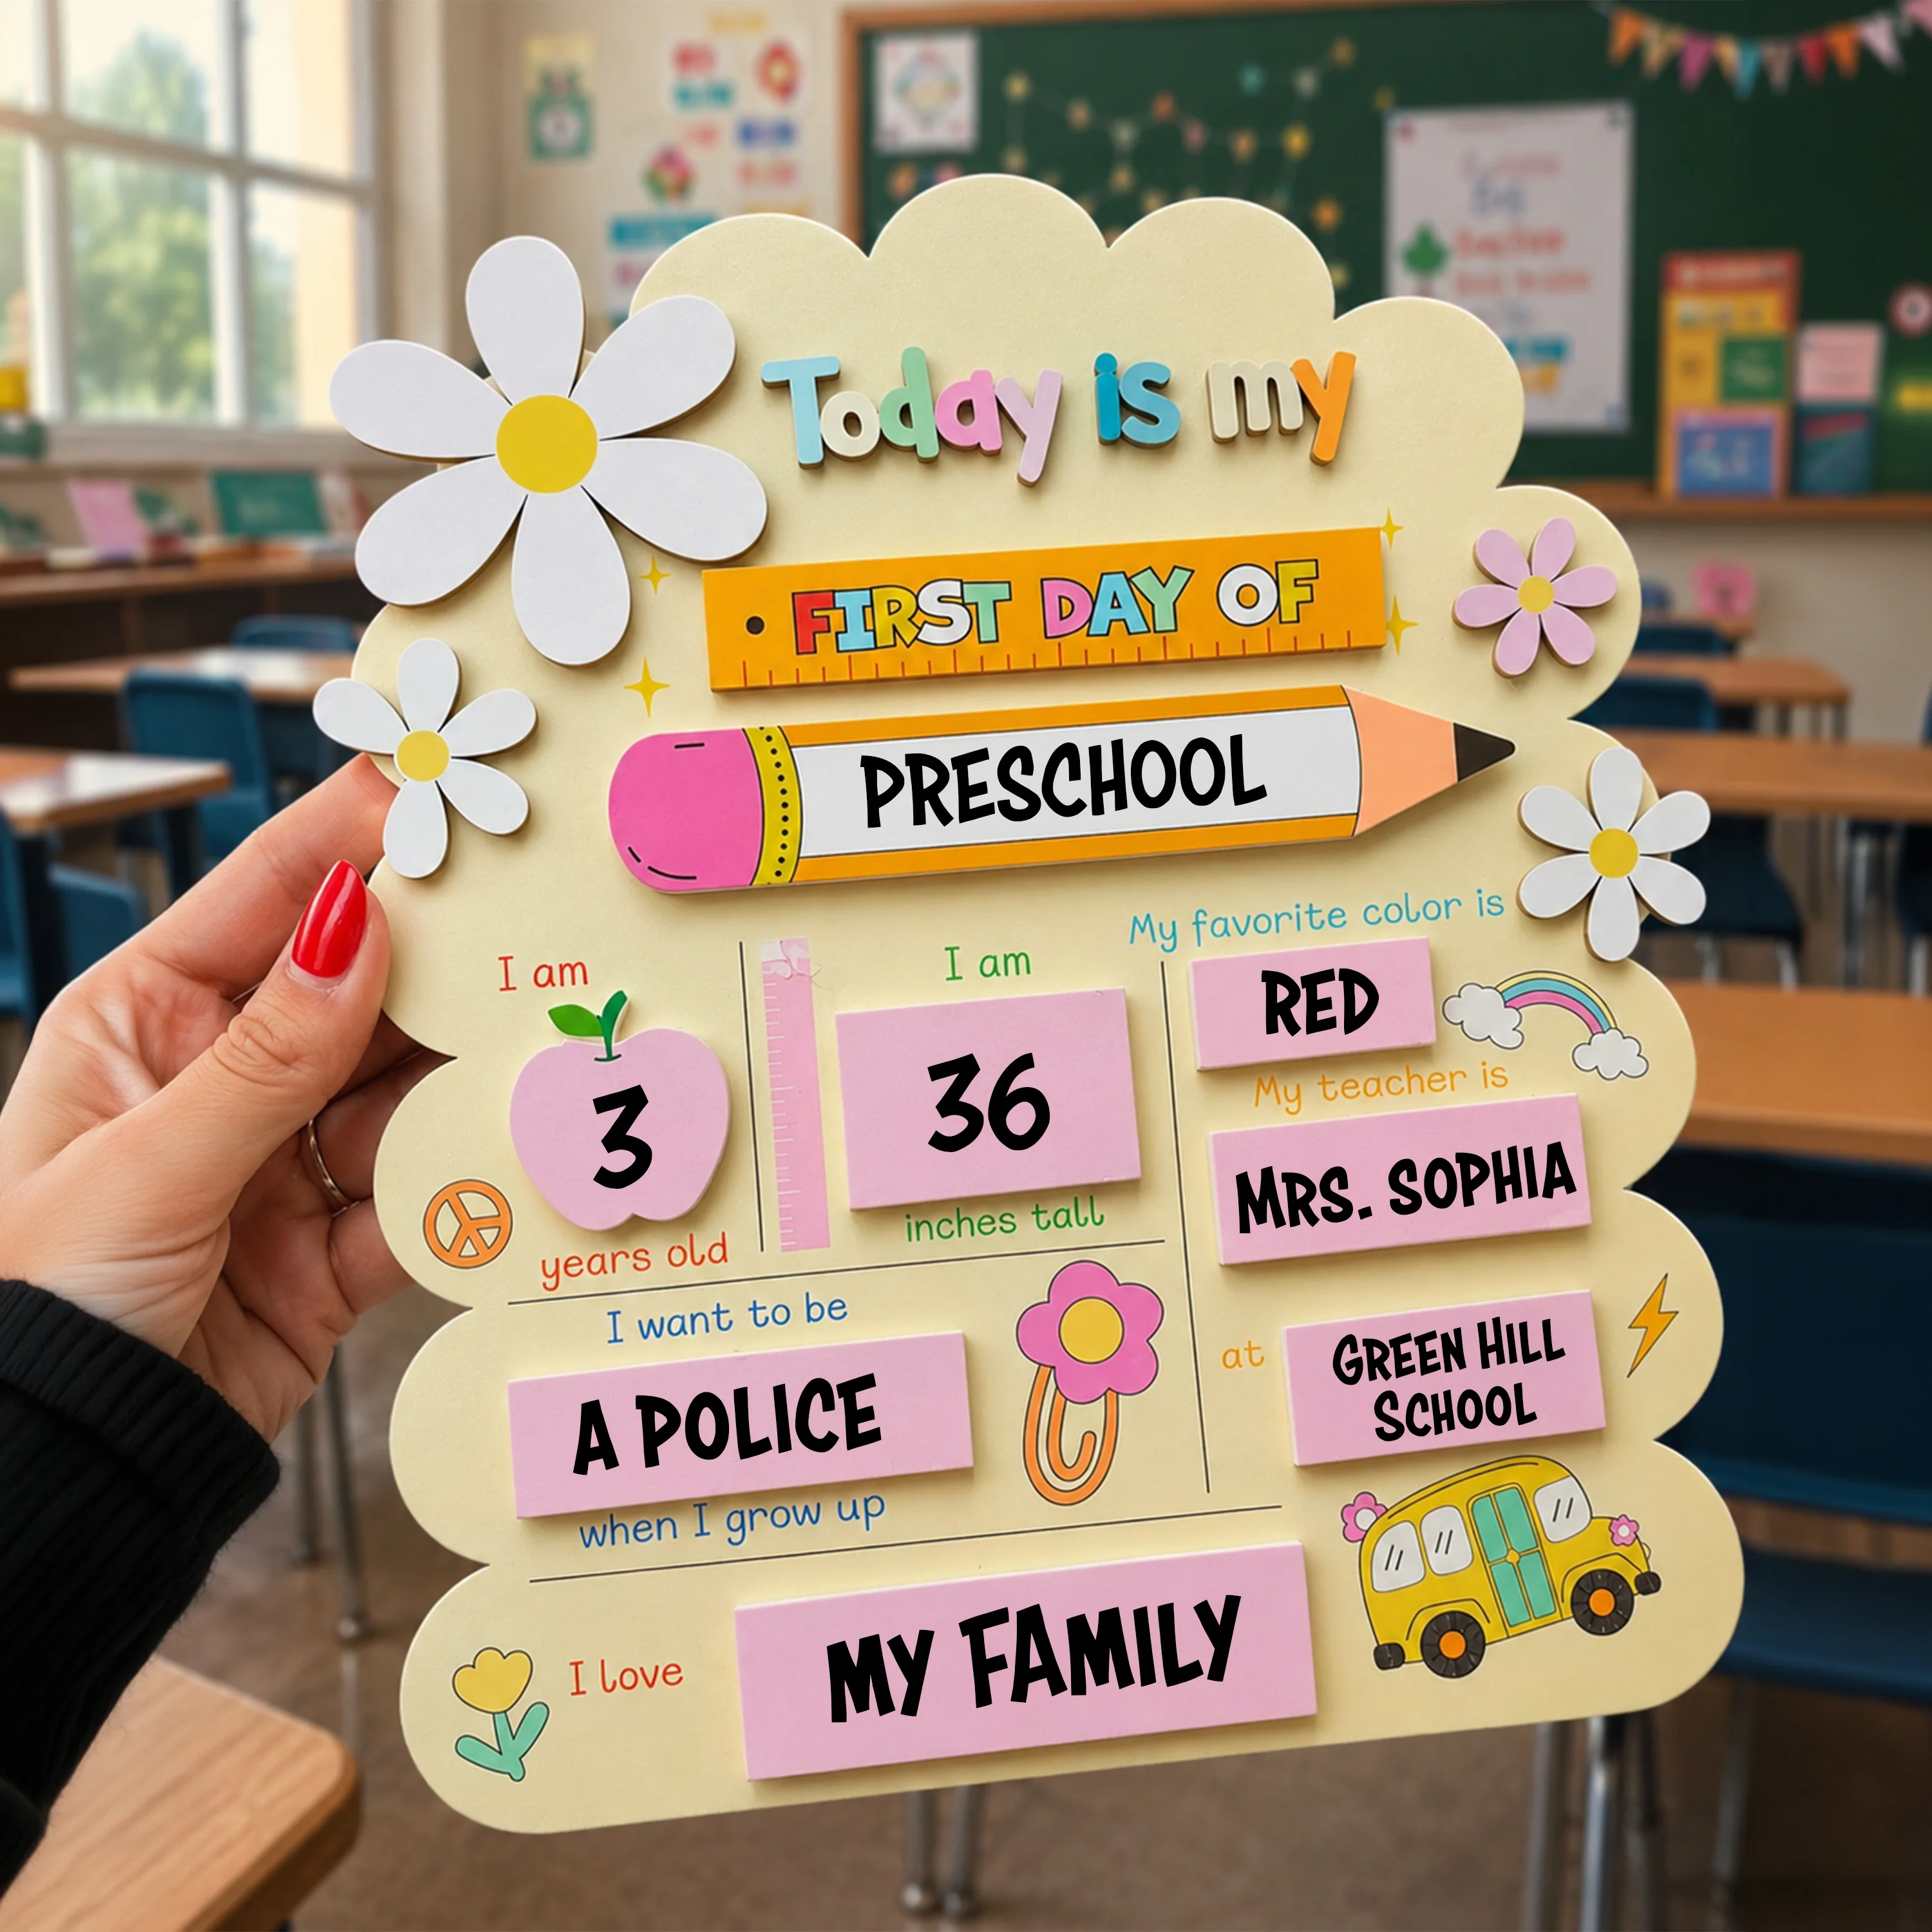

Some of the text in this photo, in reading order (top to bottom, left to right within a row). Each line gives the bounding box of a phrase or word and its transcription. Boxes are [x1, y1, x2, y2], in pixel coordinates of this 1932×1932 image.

[761, 346, 1356, 488] Today is my
[791, 558, 1319, 656] FIRST DAY OF
[860, 734, 1267, 828] PRESCHOOL
[1130, 888, 1504, 953] My favorite color is
[498, 956, 588, 992] I am
[945, 946, 1030, 981] I am
[1262, 969, 1379, 1036] RED
[928, 1053, 1050, 1152] 36
[1254, 1061, 1508, 1115] My teacher is
[593, 1084, 652, 1189] 3
[906, 1195, 1104, 1242] inches tall
[1236, 1142, 1577, 1233] MRS. SOPHIA
[541, 1231, 728, 1292] years old
[607, 1292, 848, 1344] I want to be
[1222, 1340, 1265, 1369] at
[1333, 1317, 1566, 1385] GREEN HILL
[573, 1373, 881, 1475] A POLICE
[1374, 1382, 1537, 1441] SCHOOL
[580, 1495, 885, 1548] when I grow up
[569, 1659, 683, 1696] I love
[827, 1595, 1241, 1722] MY FAMILY
